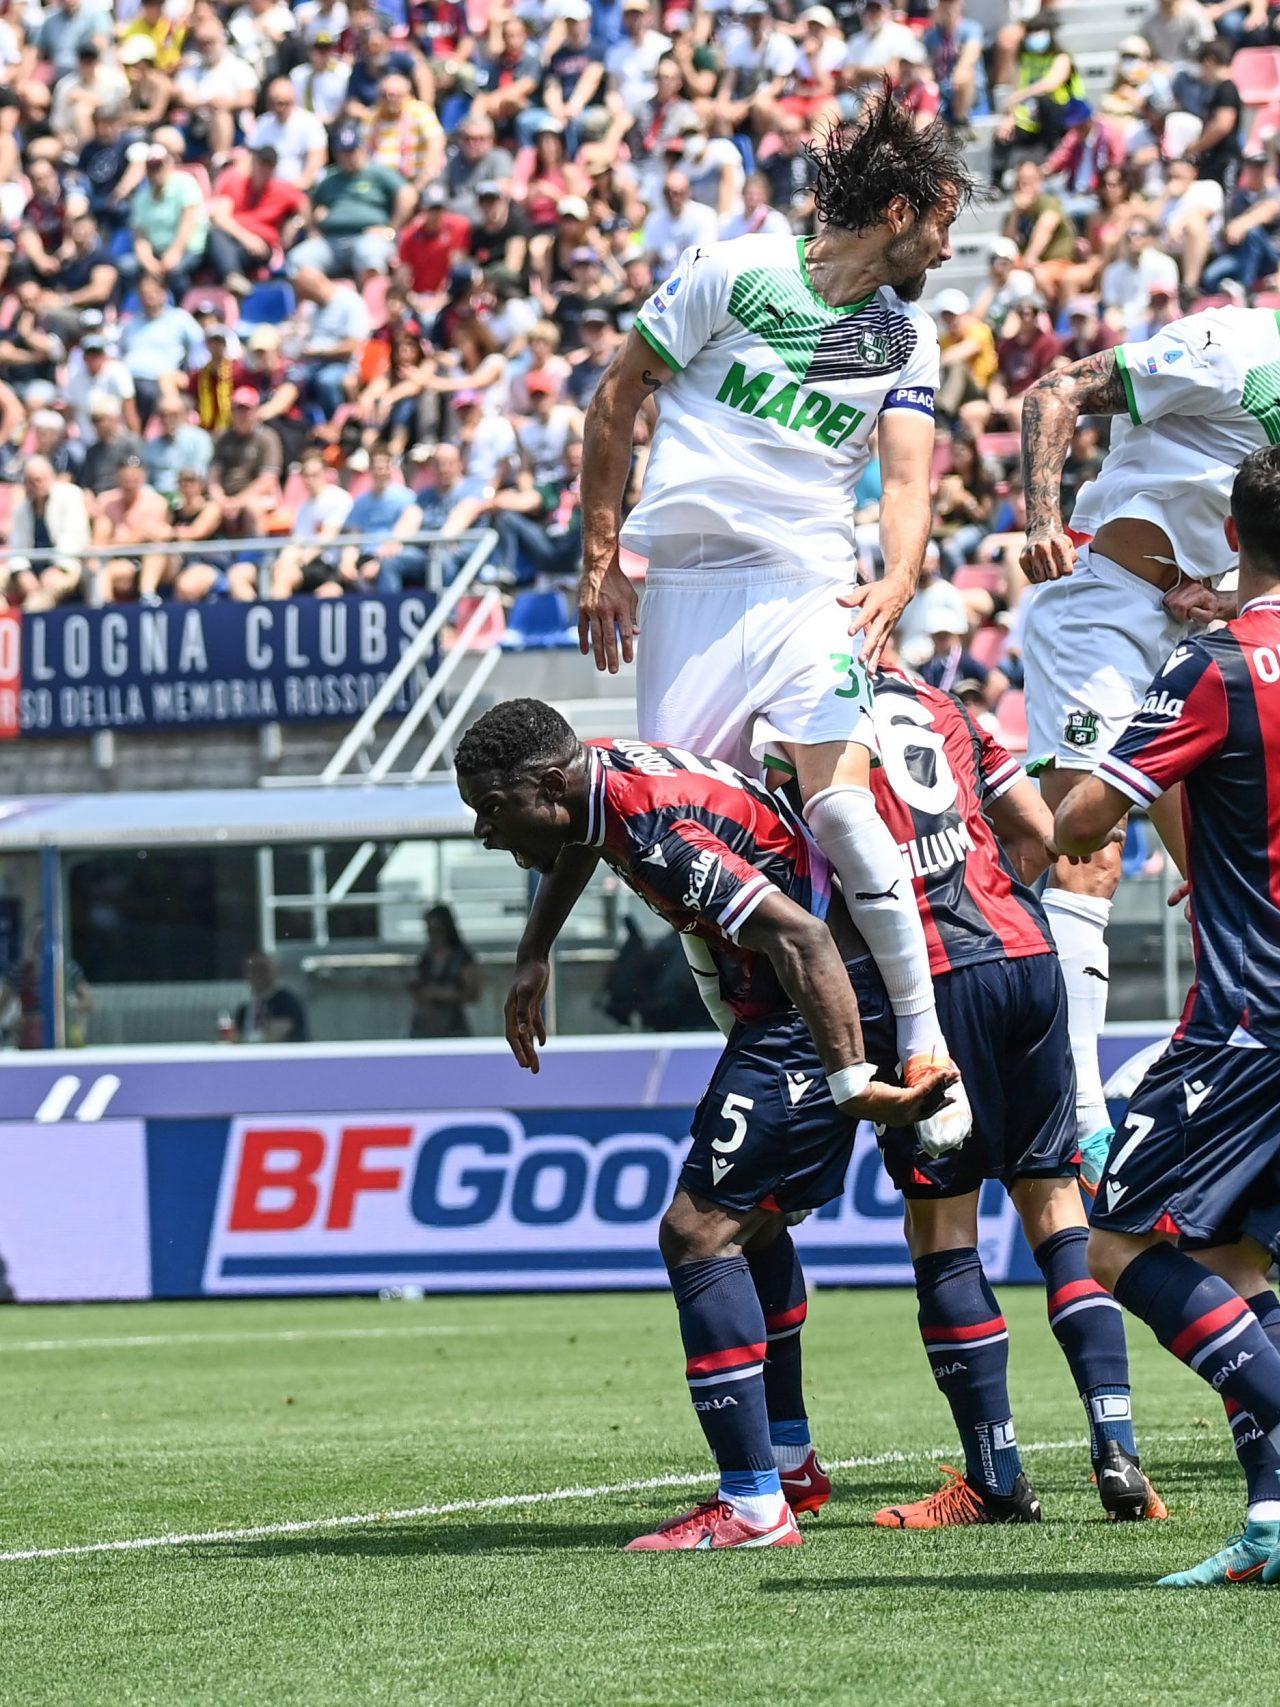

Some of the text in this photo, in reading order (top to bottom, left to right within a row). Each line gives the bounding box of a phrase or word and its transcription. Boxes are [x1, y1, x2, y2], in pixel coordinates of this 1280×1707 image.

[716, 362, 866, 449] MAPEI
[245, 598, 434, 670] CLUBS
[60, 683, 146, 727] DELLA
[152, 676, 279, 722] MEMORIA
[874, 692, 958, 816] 6
[711, 1092, 754, 1153] 5
[1109, 1112, 1155, 1175] 7
